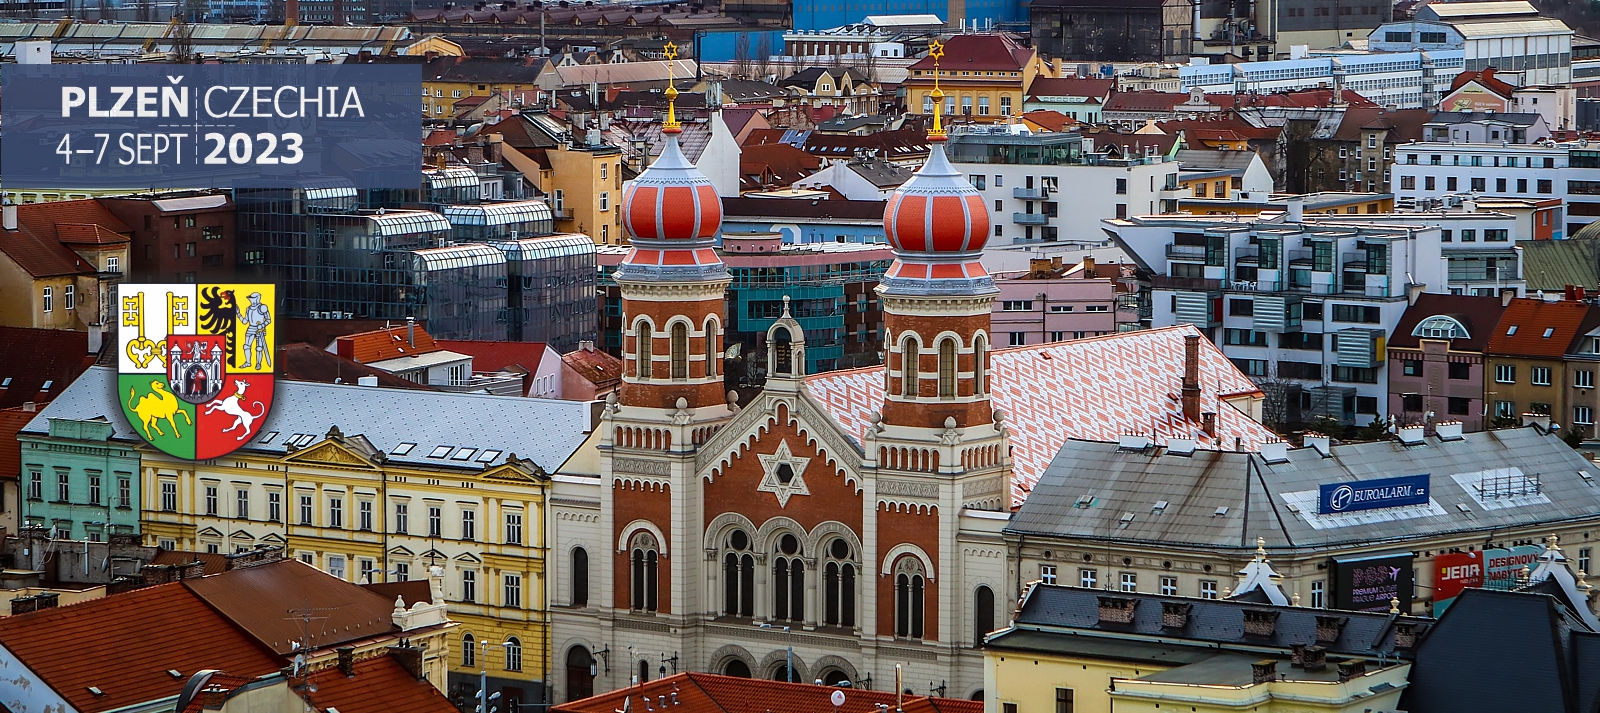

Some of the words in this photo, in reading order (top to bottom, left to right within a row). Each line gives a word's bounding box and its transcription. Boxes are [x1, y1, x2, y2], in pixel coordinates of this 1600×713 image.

[1353, 485, 1412, 502] EUROALARM
[1489, 551, 1539, 569] DESIGNOVÝ
[1488, 567, 1525, 580] NÁBYTE
[1352, 586, 1379, 596] PREMIUM
[1352, 594, 1375, 603] PRAGUE
[1375, 591, 1398, 601] AIRPORT
